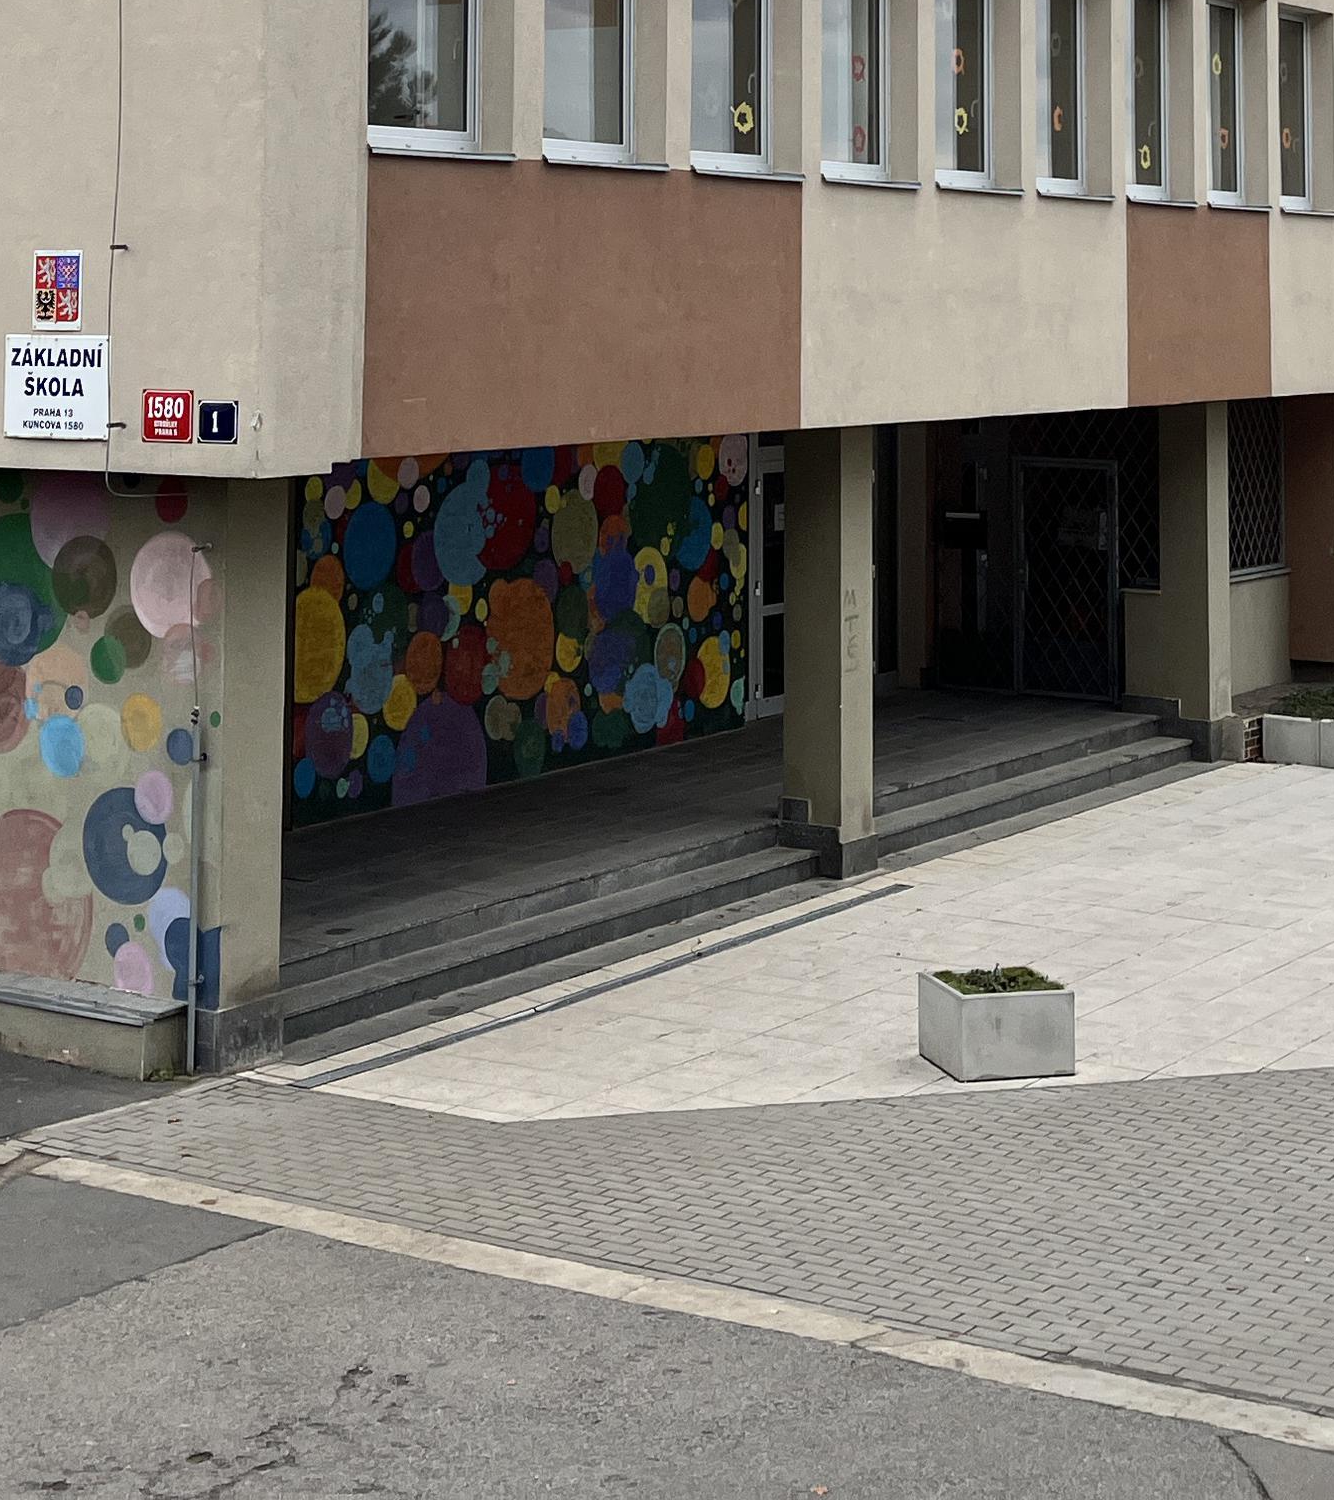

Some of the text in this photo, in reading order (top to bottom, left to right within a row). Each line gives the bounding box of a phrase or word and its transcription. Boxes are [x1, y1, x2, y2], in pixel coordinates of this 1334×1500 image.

[11, 342, 103, 368] ZÁKLADNÍ
[24, 371, 84, 397] ŠKOLA
[33, 408, 74, 418] PRAHA 13
[147, 396, 185, 419] 1580
[22, 420, 84, 431] KUNCOVA 1580
[211, 411, 219, 433] 1
